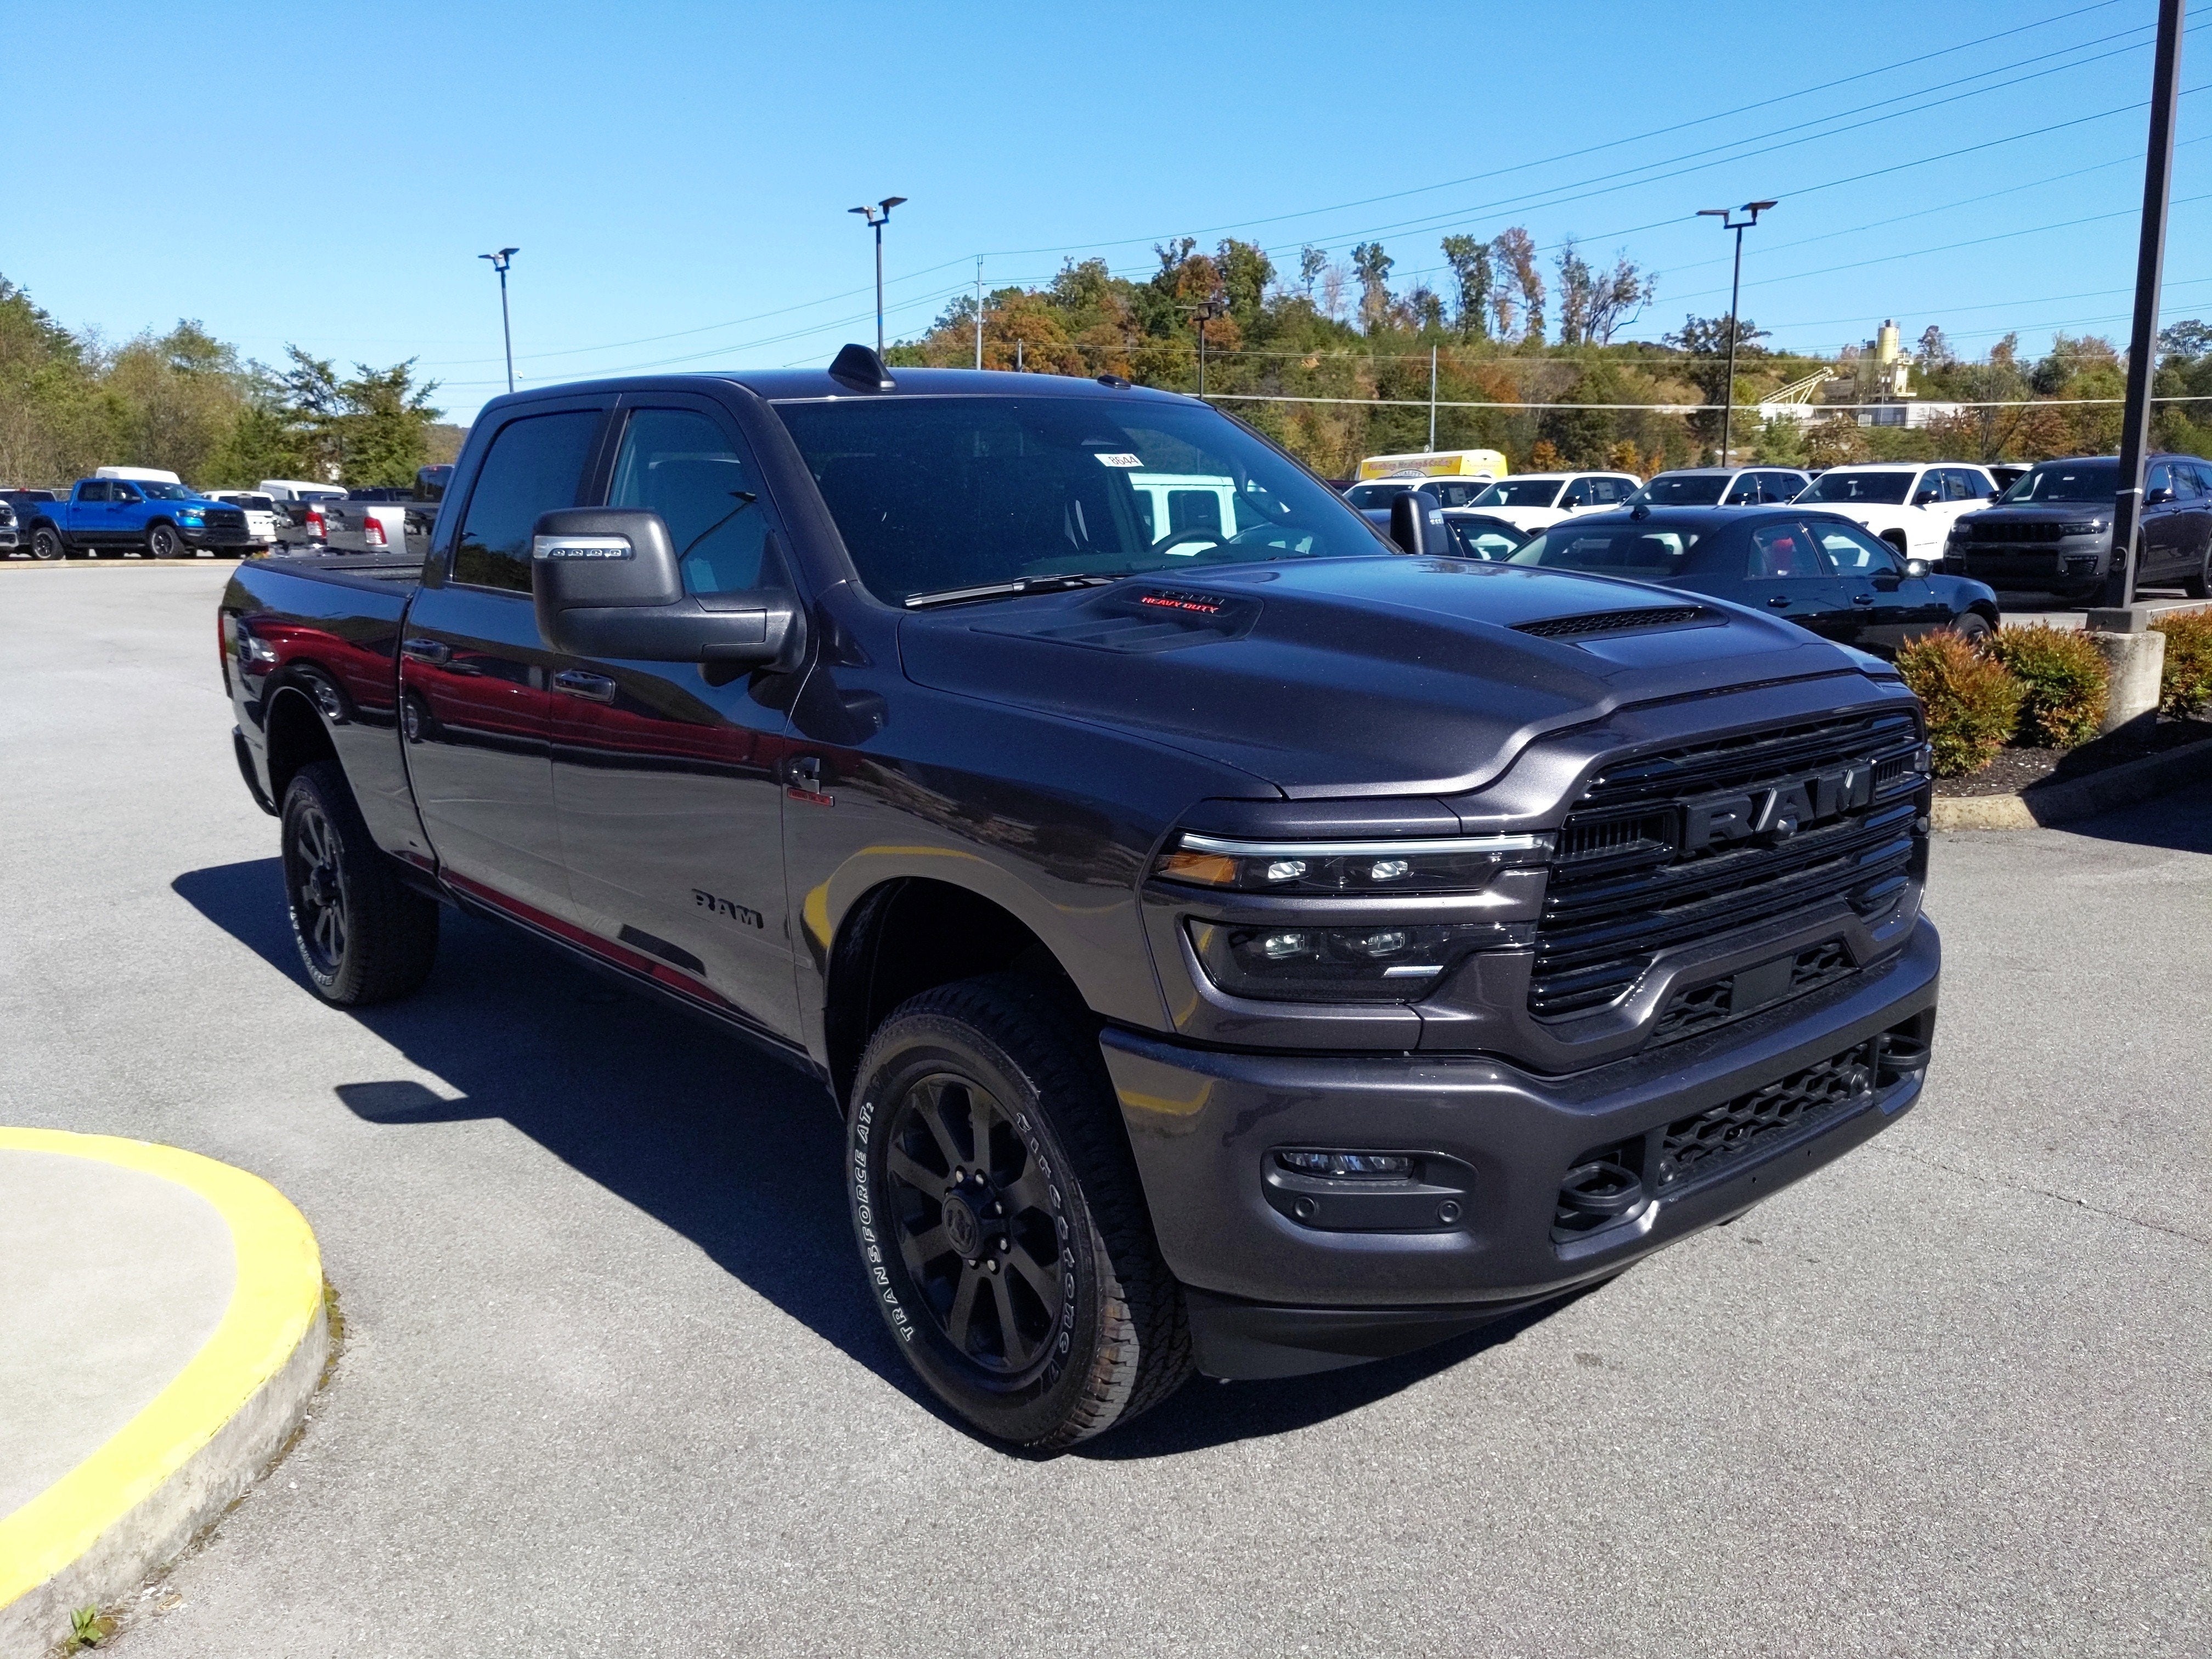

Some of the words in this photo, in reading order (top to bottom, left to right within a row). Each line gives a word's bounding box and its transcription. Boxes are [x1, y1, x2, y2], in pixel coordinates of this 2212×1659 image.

[1108, 456, 1139, 465] 8644
[1141, 597, 1182, 607] HEAVY
[1182, 603, 1219, 614] DUTY
[1685, 764, 1871, 851] RAM
[691, 888, 764, 929] RAM
[855, 1149, 914, 1342] TRANSFORCE
[1016, 1112, 1075, 1354] Firestone
